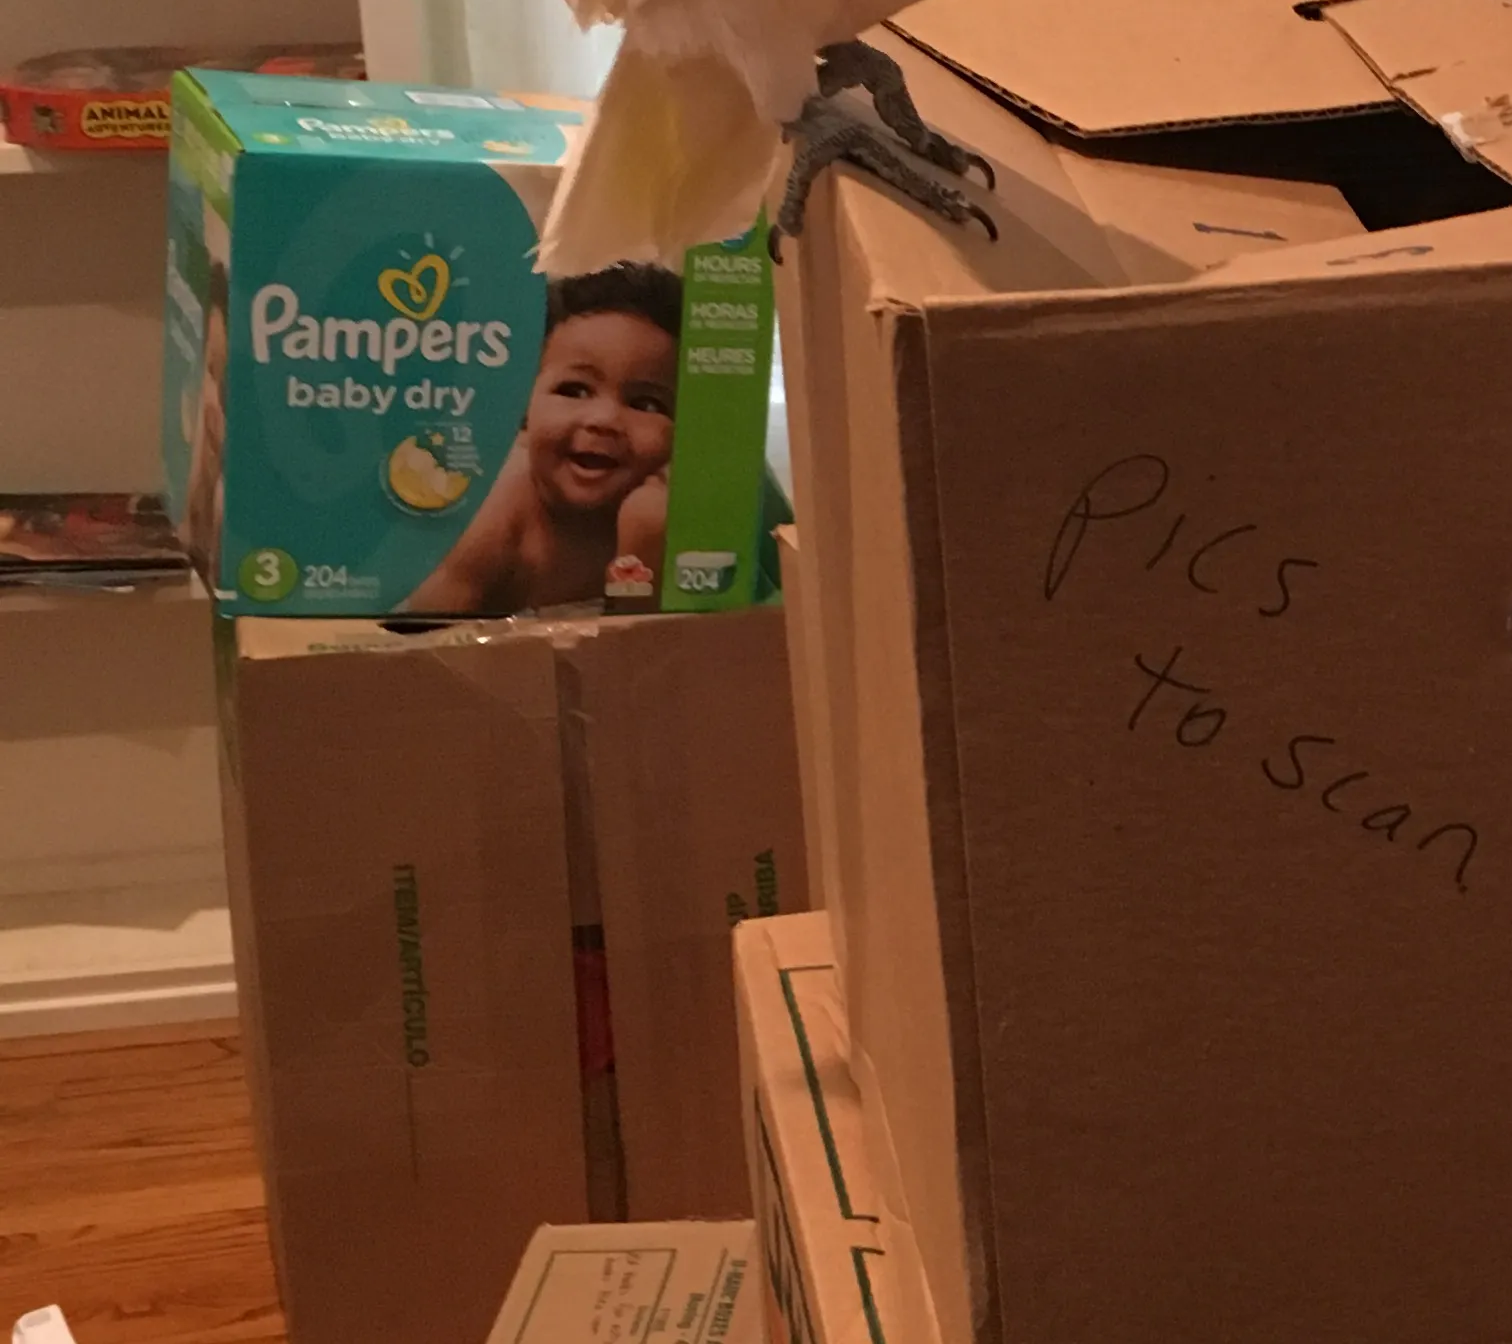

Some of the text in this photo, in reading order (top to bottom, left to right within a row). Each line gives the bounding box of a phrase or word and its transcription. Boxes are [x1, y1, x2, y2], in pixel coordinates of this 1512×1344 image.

[87, 104, 168, 121] ANIMAL
[252, 283, 512, 376] Pampers
[286, 375, 476, 417] baby dry
[253, 550, 281, 587] 3
[302, 563, 349, 589] 204
[679, 567, 720, 591] 204
[1128, 644, 1227, 747] to
